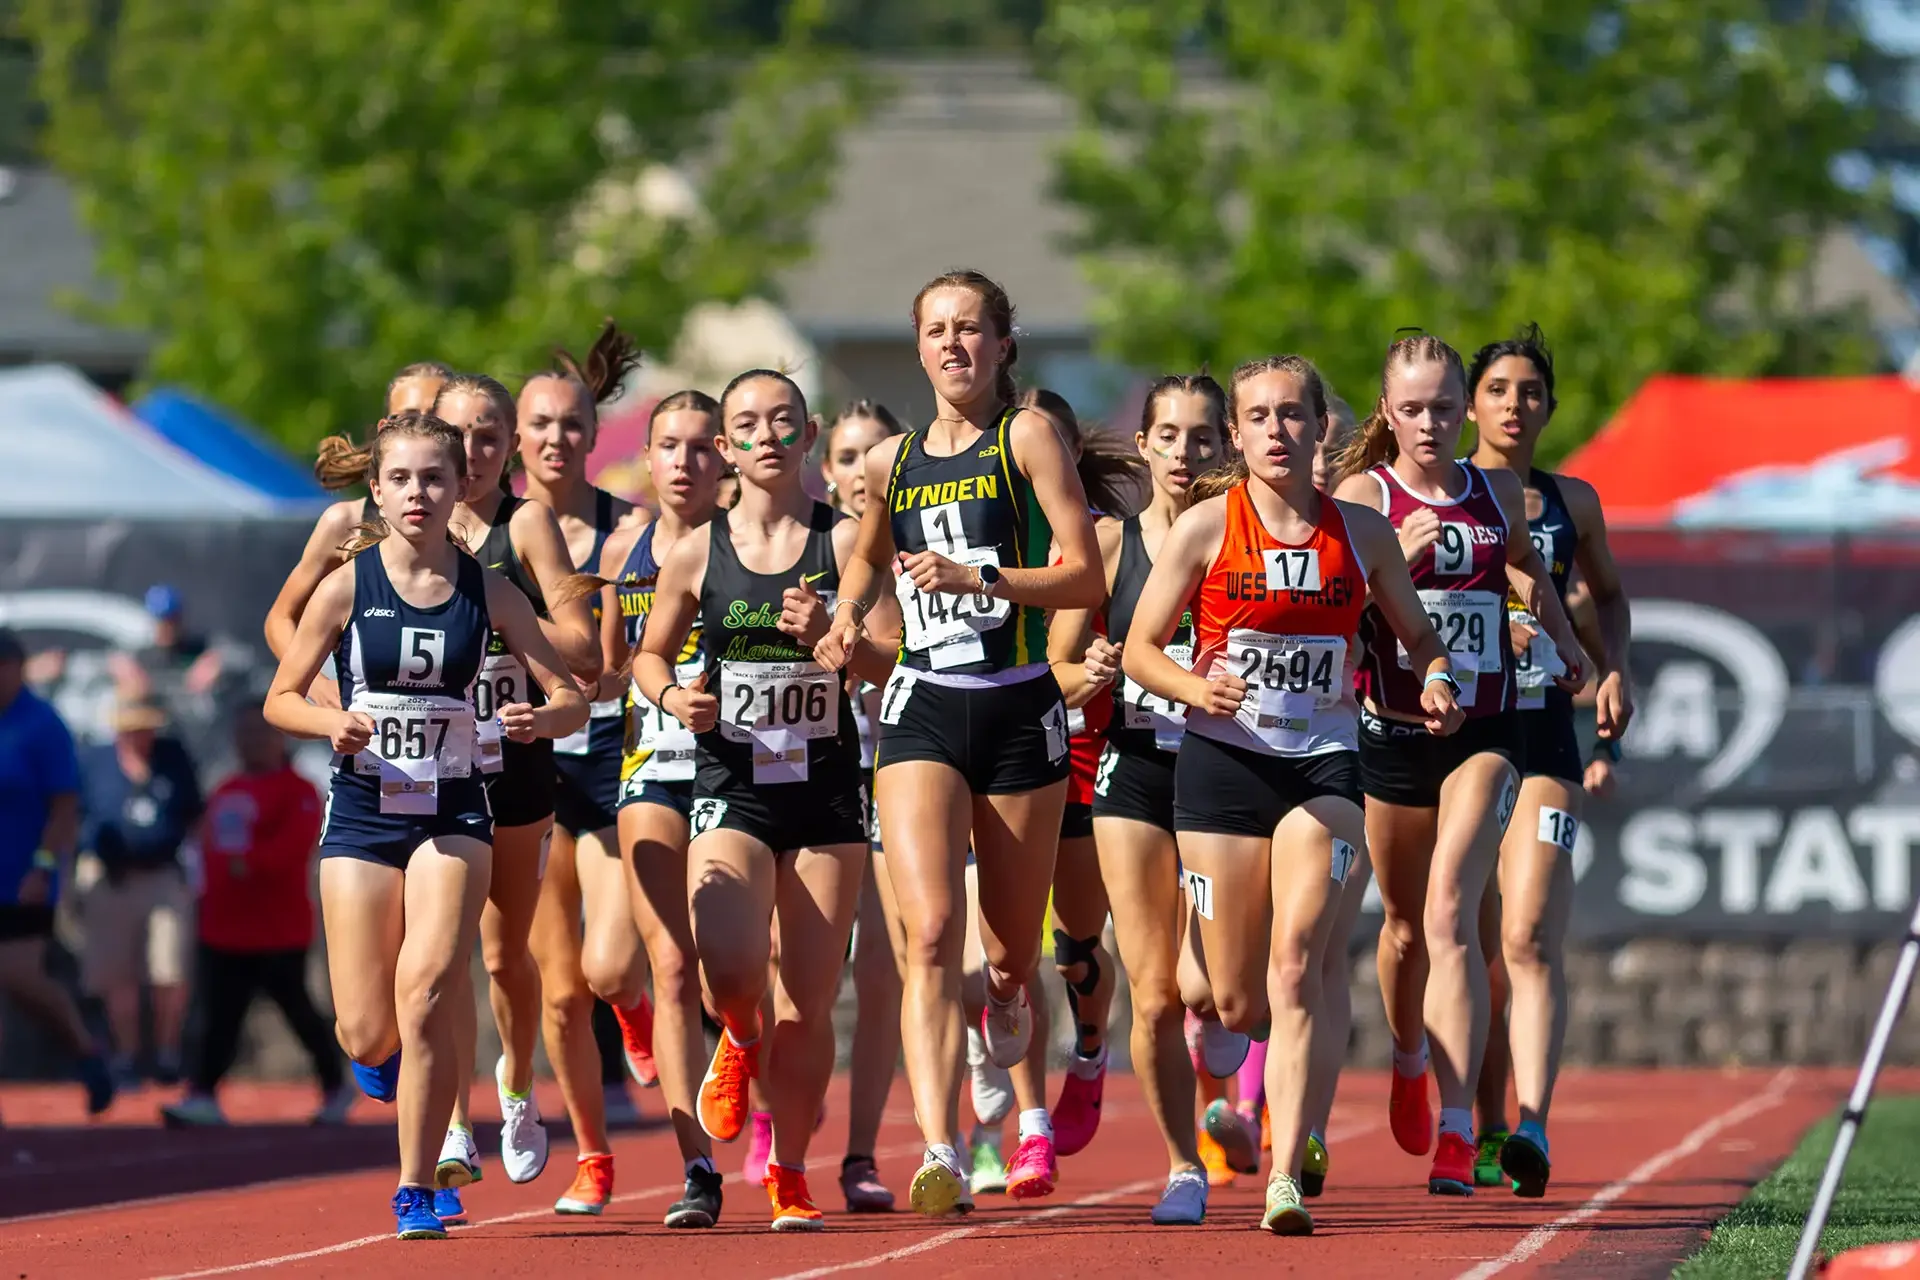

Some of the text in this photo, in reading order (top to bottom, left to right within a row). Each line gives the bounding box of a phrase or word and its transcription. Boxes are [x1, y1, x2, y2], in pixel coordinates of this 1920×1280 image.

[894, 474, 998, 514] LYNDEN
[933, 508, 955, 555] 1
[1440, 524, 1465, 572] 9
[1274, 551, 1310, 587] 17
[373, 607, 395, 618] asics
[408, 631, 436, 681] 5
[1240, 647, 1334, 694] 2594
[407, 696, 428, 704] 2025
[734, 683, 827, 727] 2106
[885, 675, 905, 721] 1
[380, 716, 451, 762] 657
[1277, 717, 1291, 727] 17
[404, 782, 412, 791] 5
[1548, 810, 1576, 846] 18
[1618, 804, 1920, 916] STAT
[1189, 872, 1208, 914] 17
